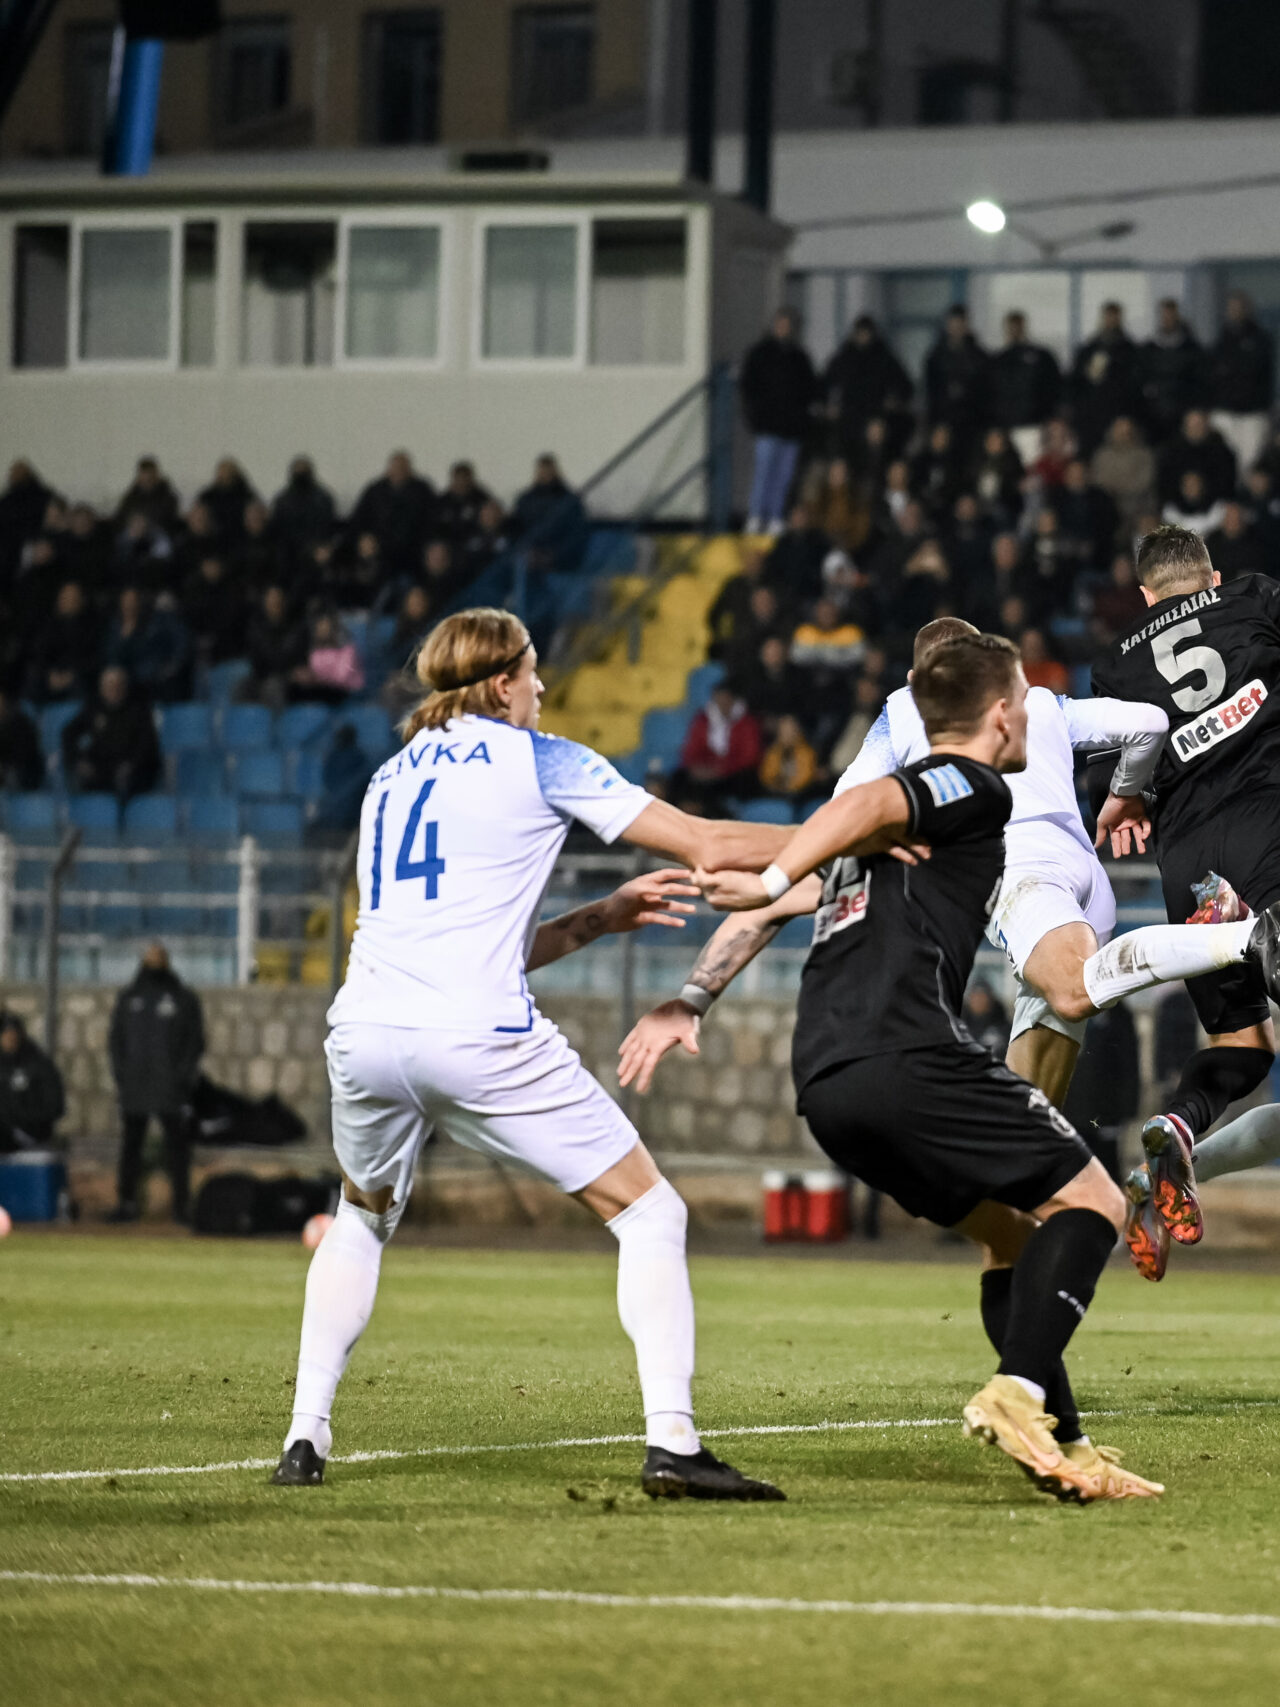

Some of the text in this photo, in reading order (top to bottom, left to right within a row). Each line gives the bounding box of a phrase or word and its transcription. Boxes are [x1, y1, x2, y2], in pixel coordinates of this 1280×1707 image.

[1150, 617, 1227, 713] 5
[1176, 687, 1264, 755] NetBet
[370, 777, 446, 911] 14
